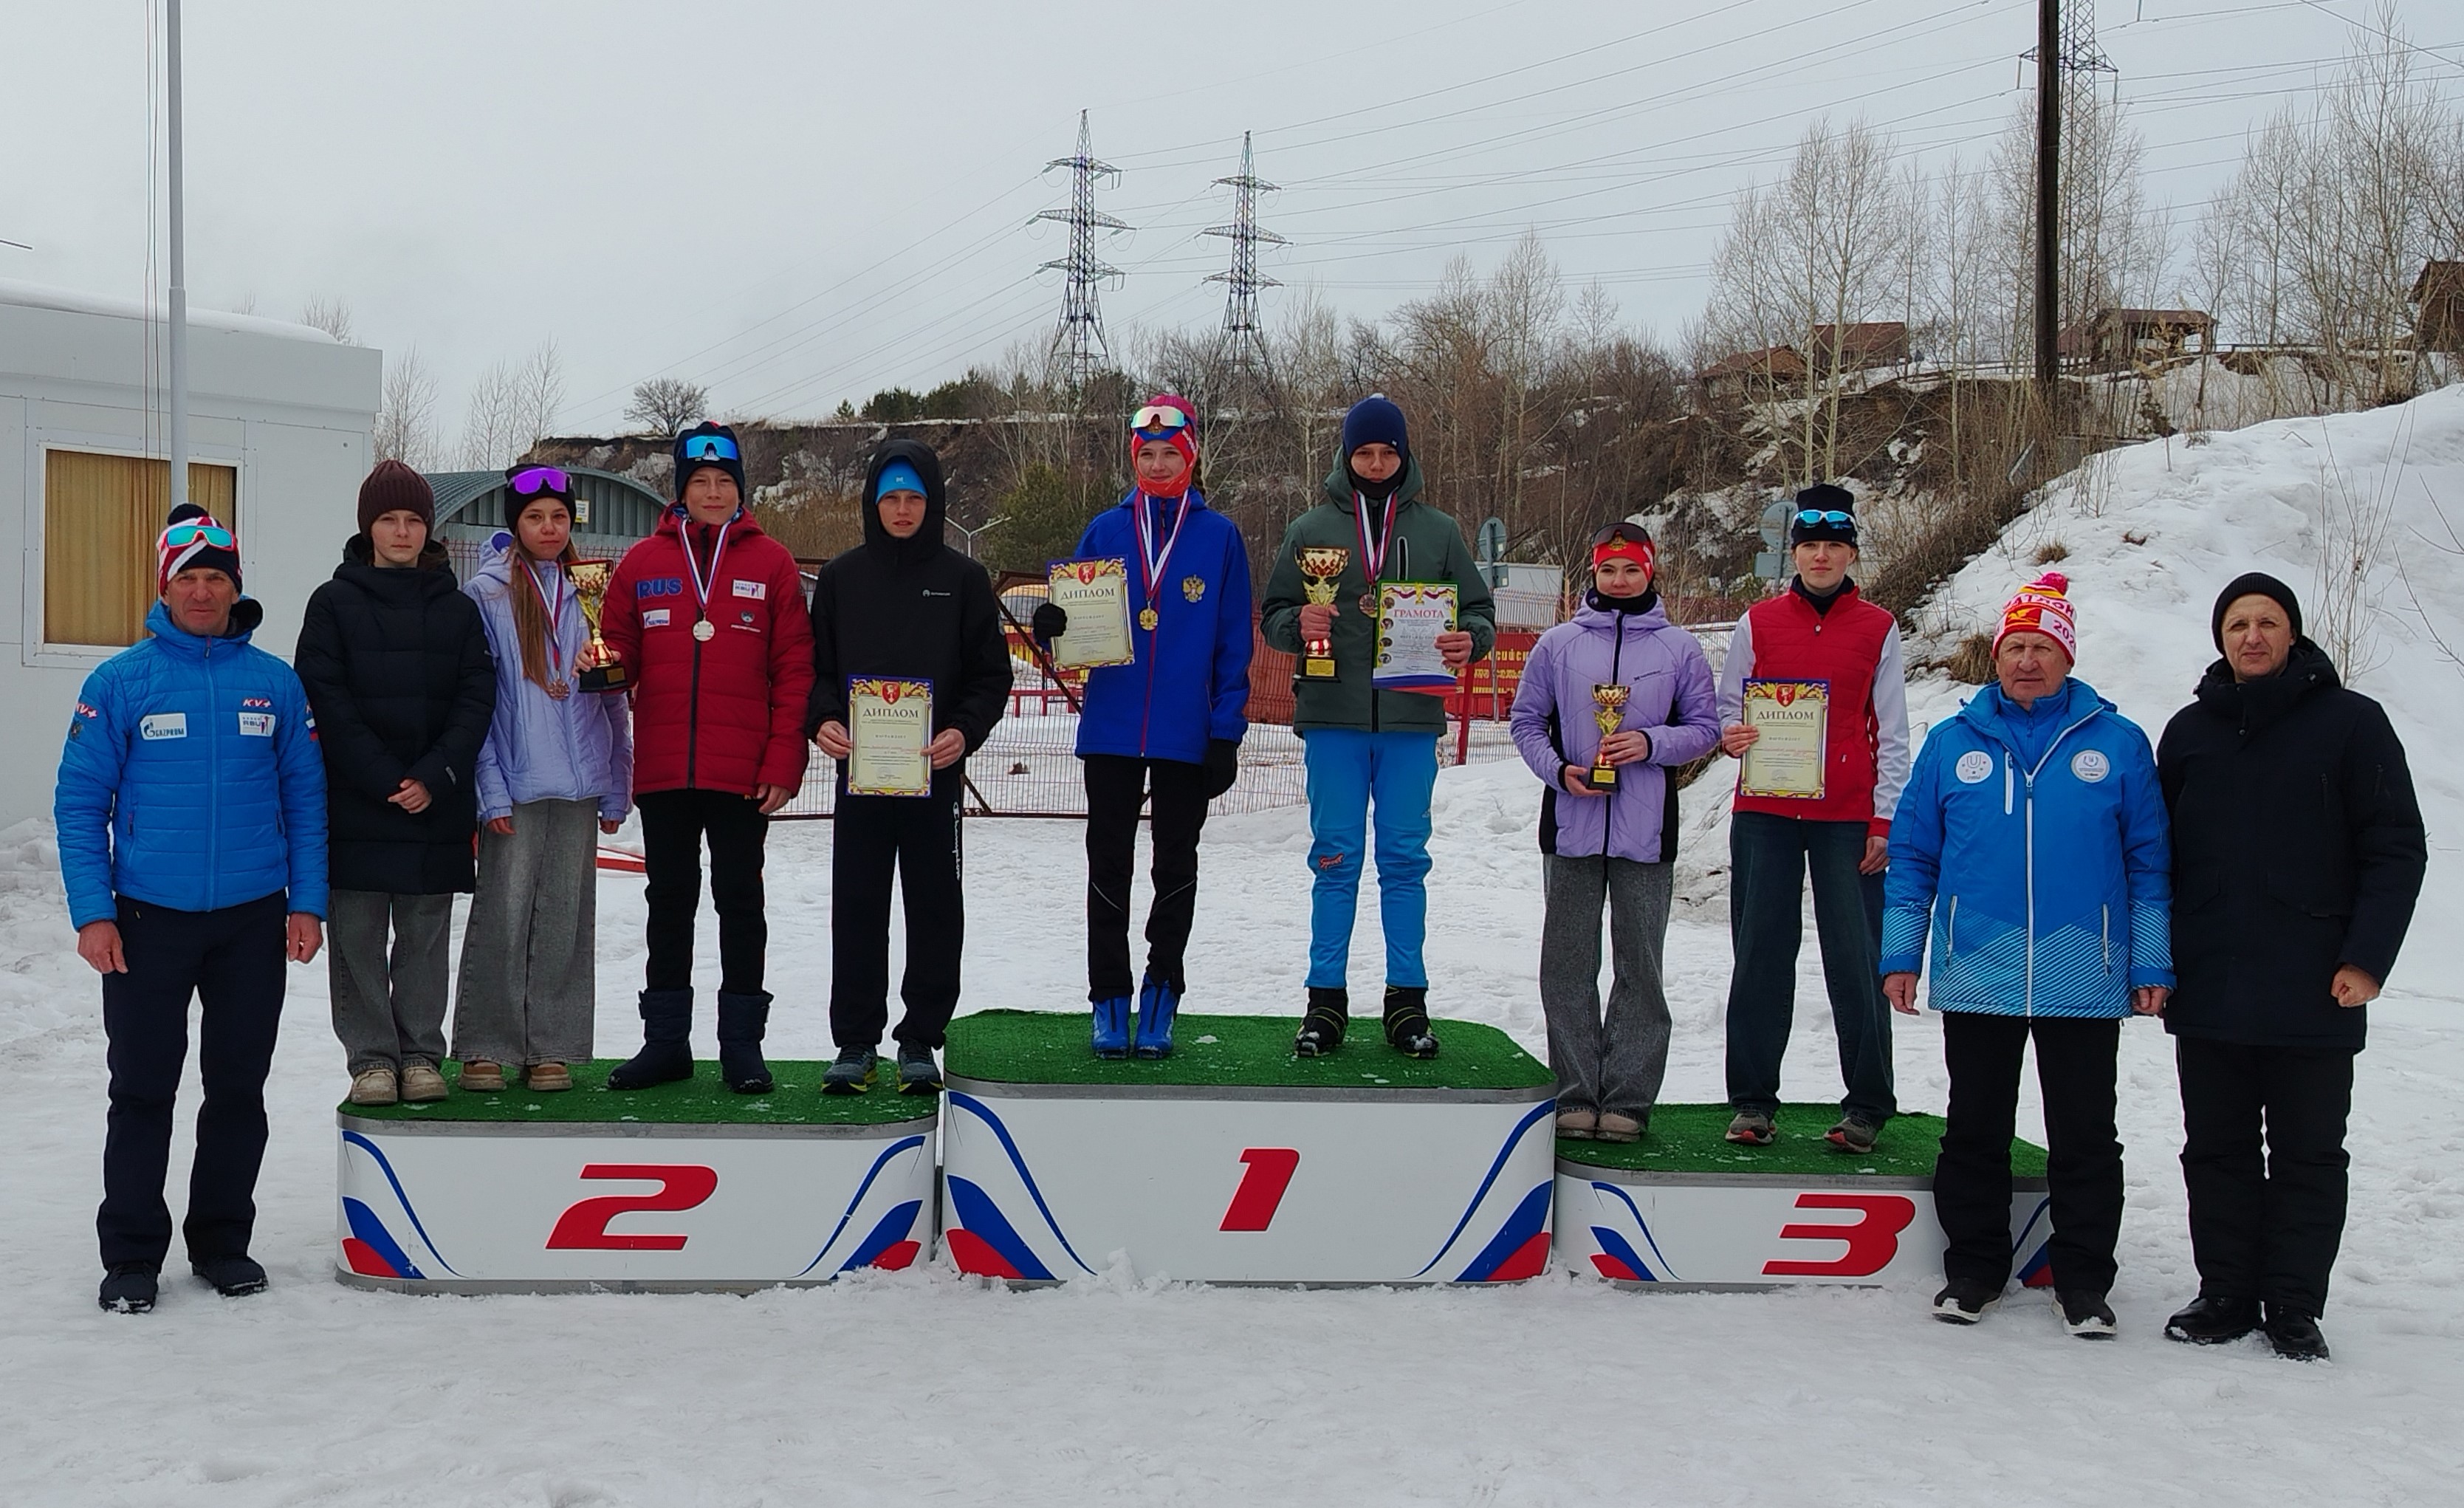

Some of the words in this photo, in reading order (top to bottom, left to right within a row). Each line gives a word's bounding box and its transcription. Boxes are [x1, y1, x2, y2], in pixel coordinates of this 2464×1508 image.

[636, 578, 682, 599] RUS
[1060, 588, 1115, 600] ДИПЛОМ
[1393, 609, 1444, 618] ГРАМОТА
[862, 708, 919, 719] ДИПЛОМ
[1756, 710, 1813, 720] ДИПЛОМ
[1221, 1148, 1298, 1230] 1
[547, 1165, 716, 1249] 2
[1763, 1194, 1913, 1275] 3
